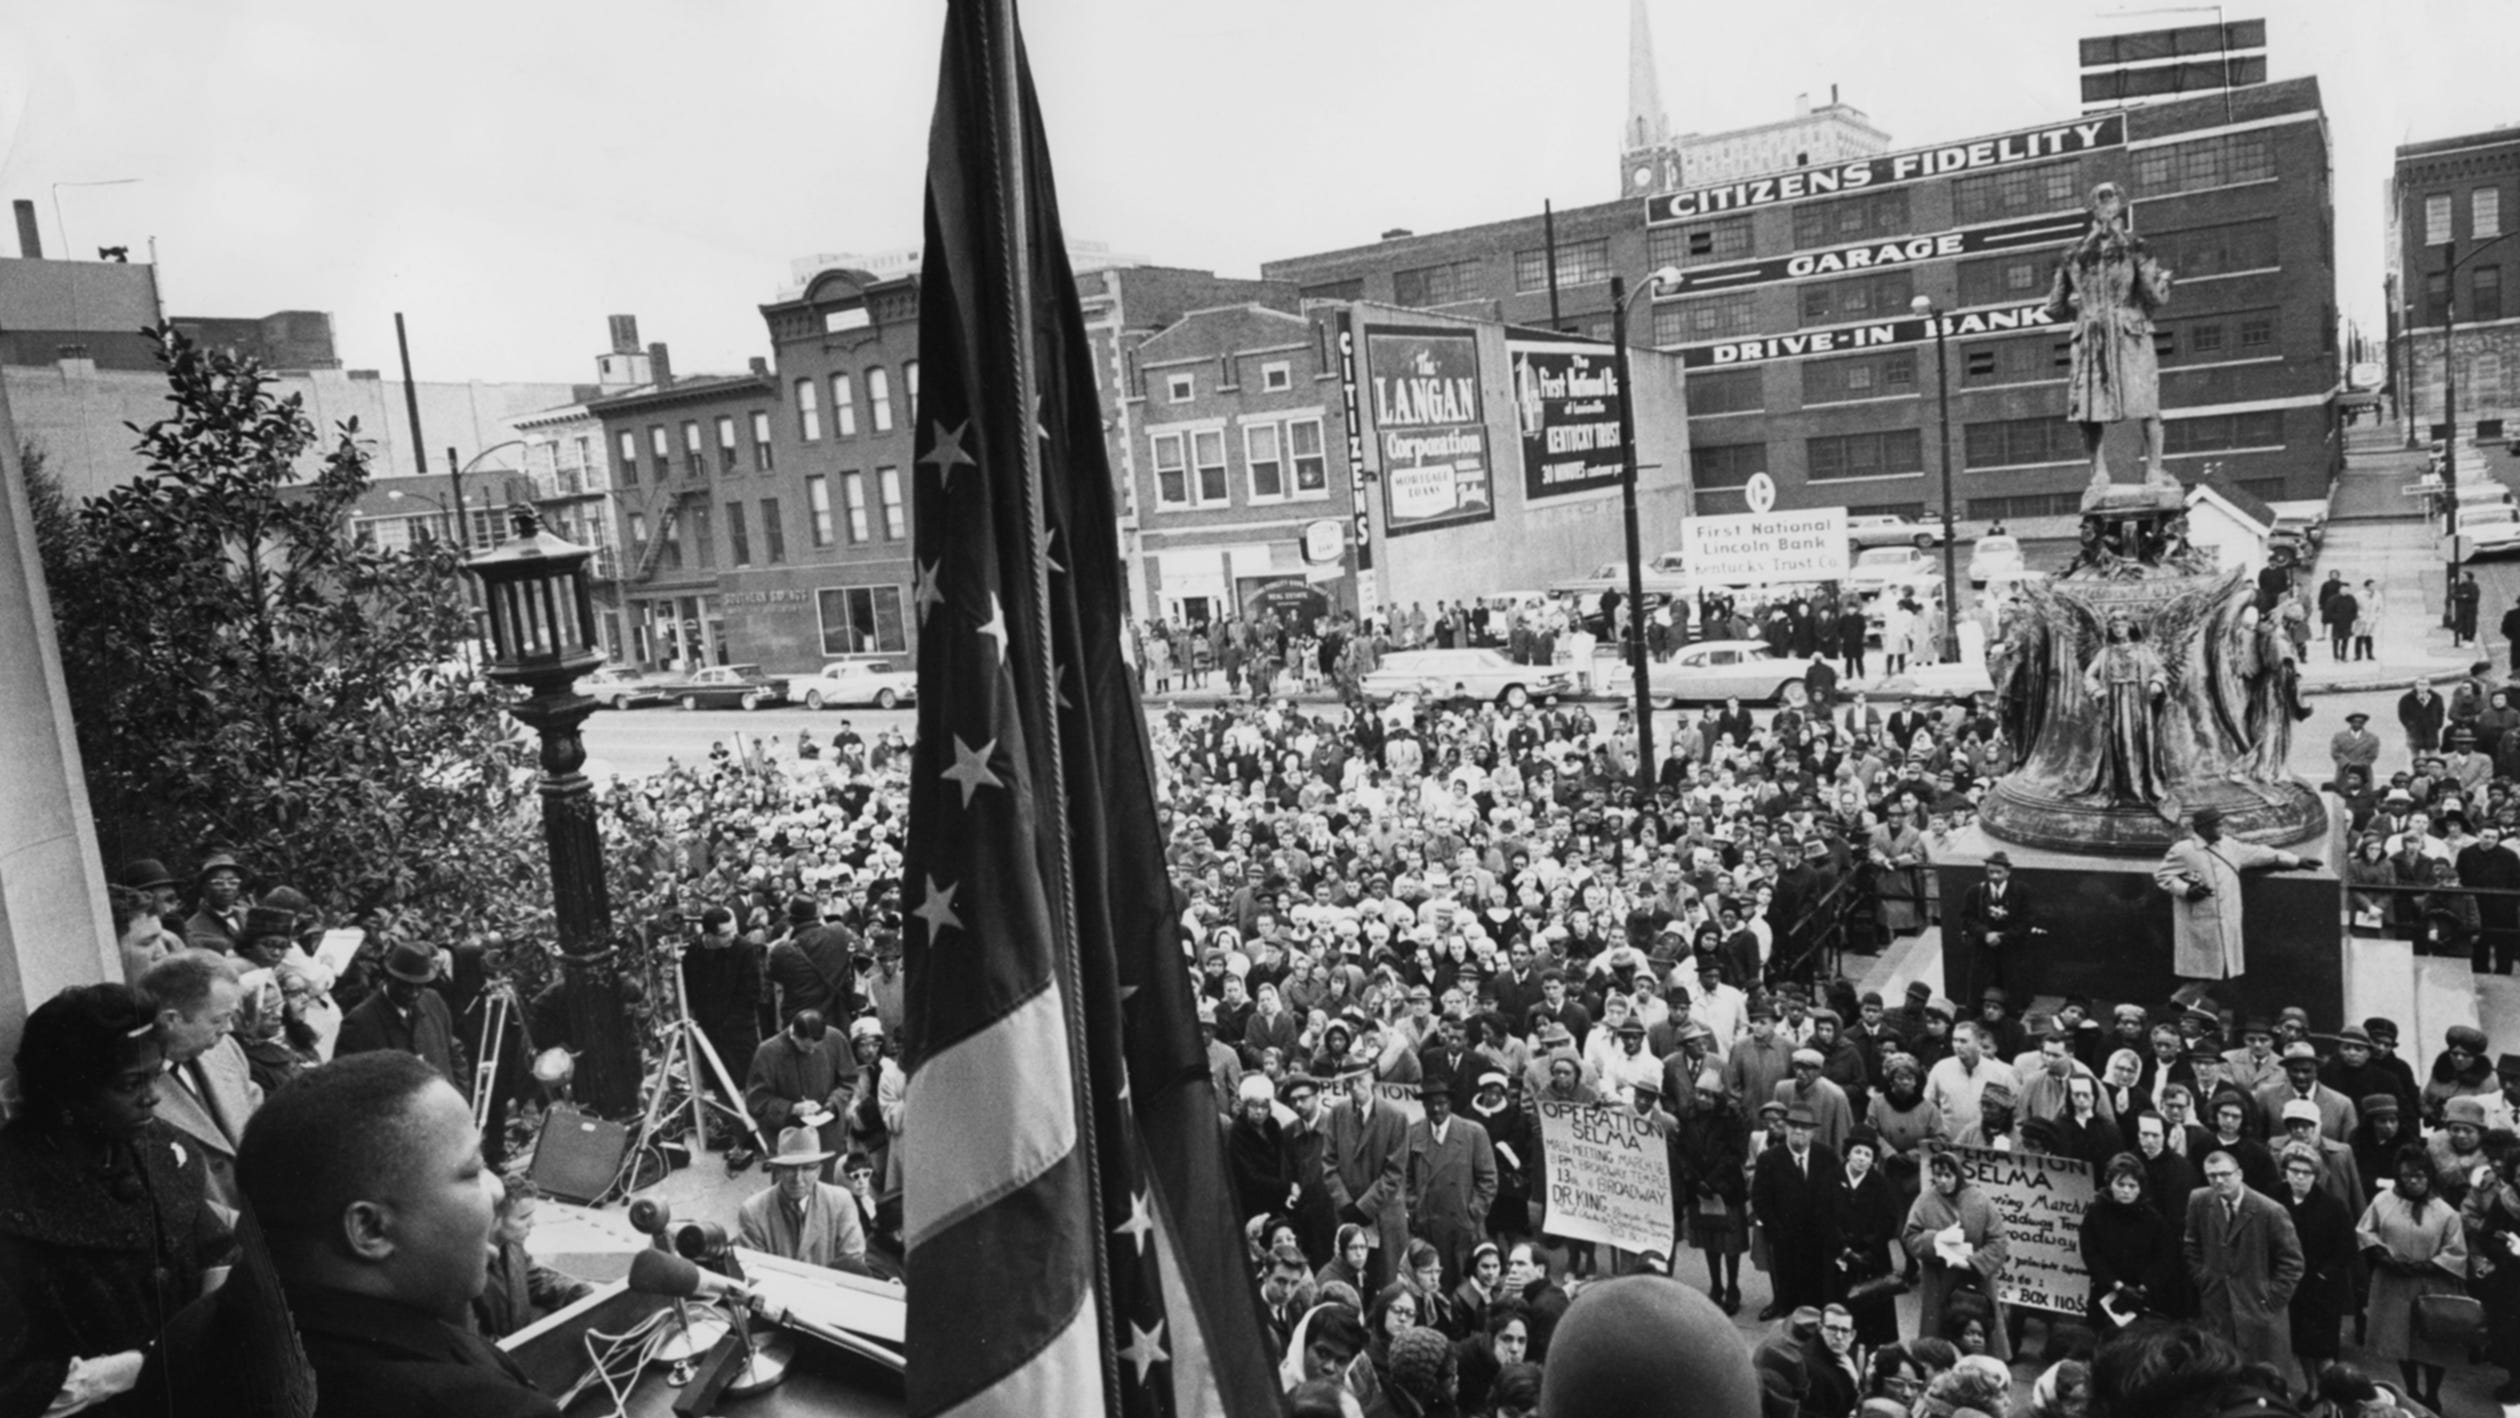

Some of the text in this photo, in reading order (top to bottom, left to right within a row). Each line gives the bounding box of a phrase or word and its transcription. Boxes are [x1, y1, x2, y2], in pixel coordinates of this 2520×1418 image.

[1669, 122, 2104, 217] CITIZENS FIDELITY
[1787, 234, 1965, 277] GARAGE
[1713, 305, 2054, 364] DRIVE-IN BANK
[1571, 355, 1589, 368] The
[1539, 366, 1566, 398] First
[1375, 377, 1474, 424] LANGAN
[1340, 332, 1369, 546] CITIZENS
[1387, 429, 1481, 467] Corporation
[1547, 421, 1620, 453] KENTUCKY TRUST
[1696, 519, 1831, 539] First National
[1703, 536, 1825, 555] Lincoln Bank
[1773, 557, 1811, 572] Trust
[1542, 1102, 1664, 1139] OPERATION
[1572, 1123, 1642, 1152] SELMA
[1572, 1145, 1615, 1163] MEETING
[1961, 1160, 2054, 1191] SELMA
[1597, 1177, 1666, 1206] BROADWAY
[2030, 1195, 2081, 1214] March
[2019, 1288, 2049, 1307] BOX
